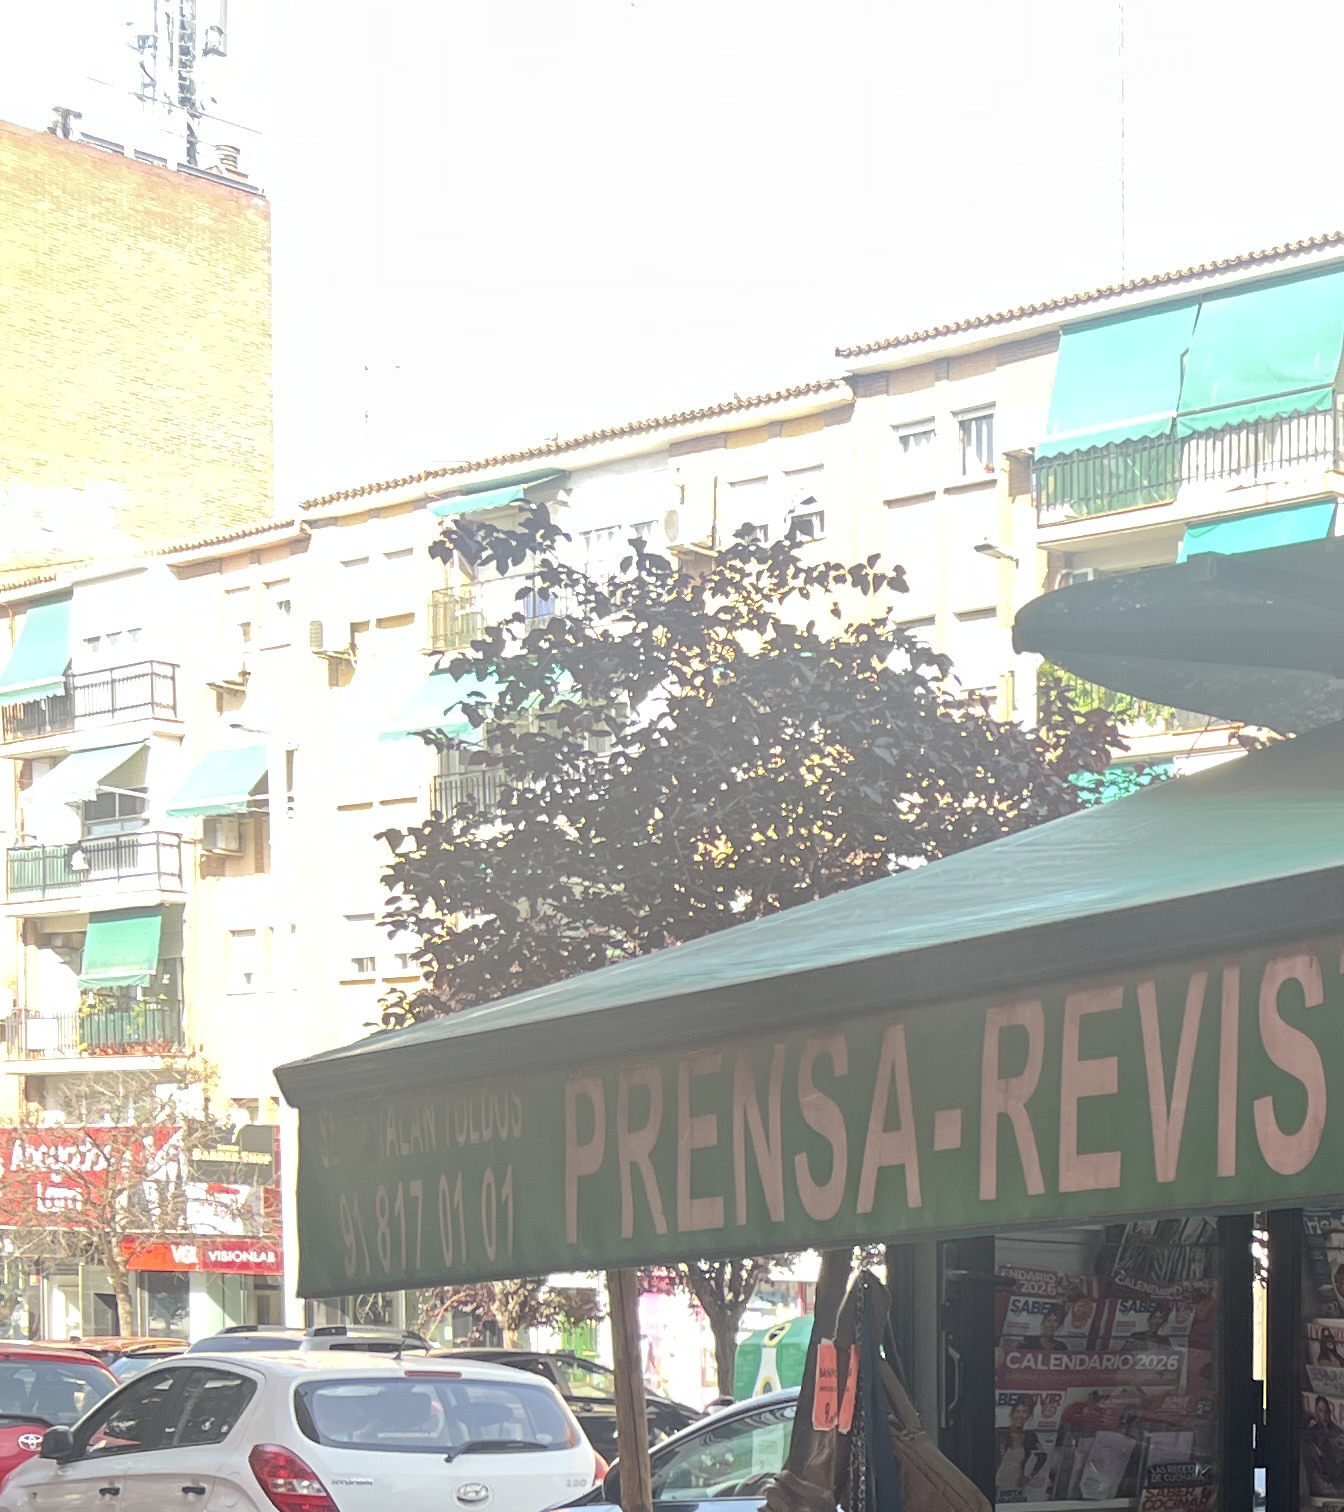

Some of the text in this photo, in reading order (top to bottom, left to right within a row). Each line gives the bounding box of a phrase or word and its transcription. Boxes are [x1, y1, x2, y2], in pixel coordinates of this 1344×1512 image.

[375, 1178, 424, 1275] 817
[438, 1170, 467, 1268] 01
[480, 1163, 515, 1264] 01
[207, 1250, 276, 1264] VISIONLAB
[1019, 1280, 1057, 1296] 2026
[1005, 1352, 1179, 1371] CALENDARIO 2026
